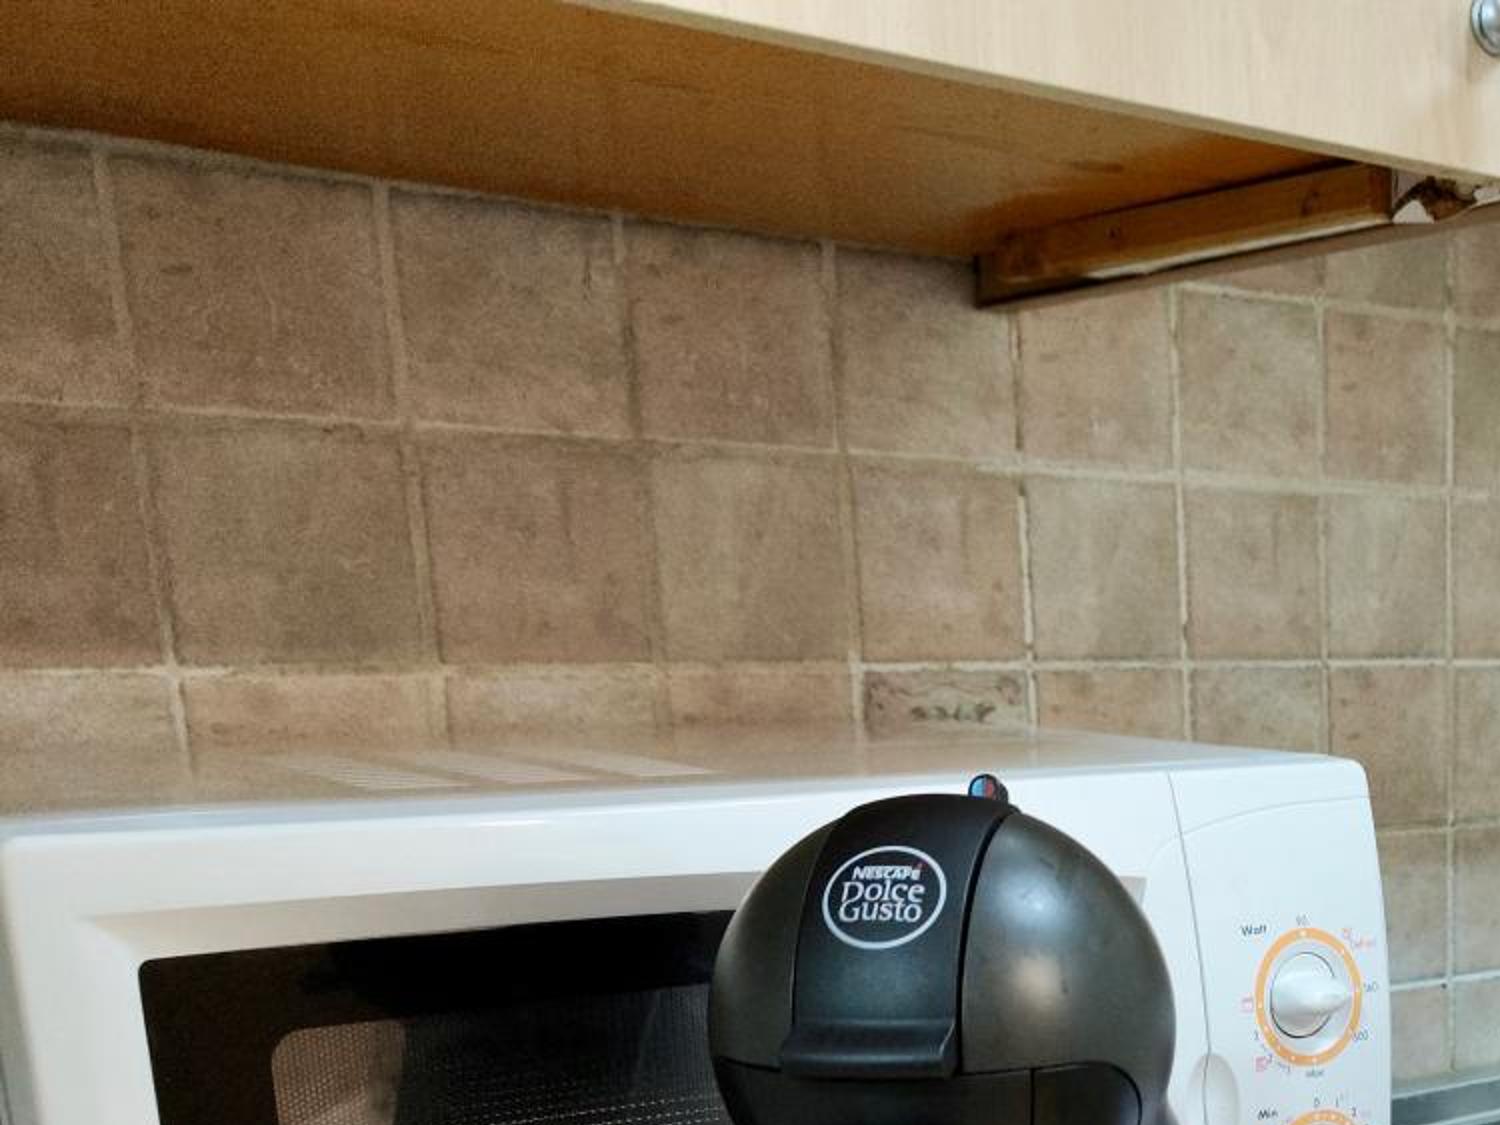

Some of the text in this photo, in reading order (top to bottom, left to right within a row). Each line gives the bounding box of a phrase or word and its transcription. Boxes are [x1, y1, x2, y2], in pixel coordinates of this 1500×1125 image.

[841, 880, 926, 903] Dolce
[838, 900, 923, 923] Gusto
[1257, 1109, 1278, 1120] Min
